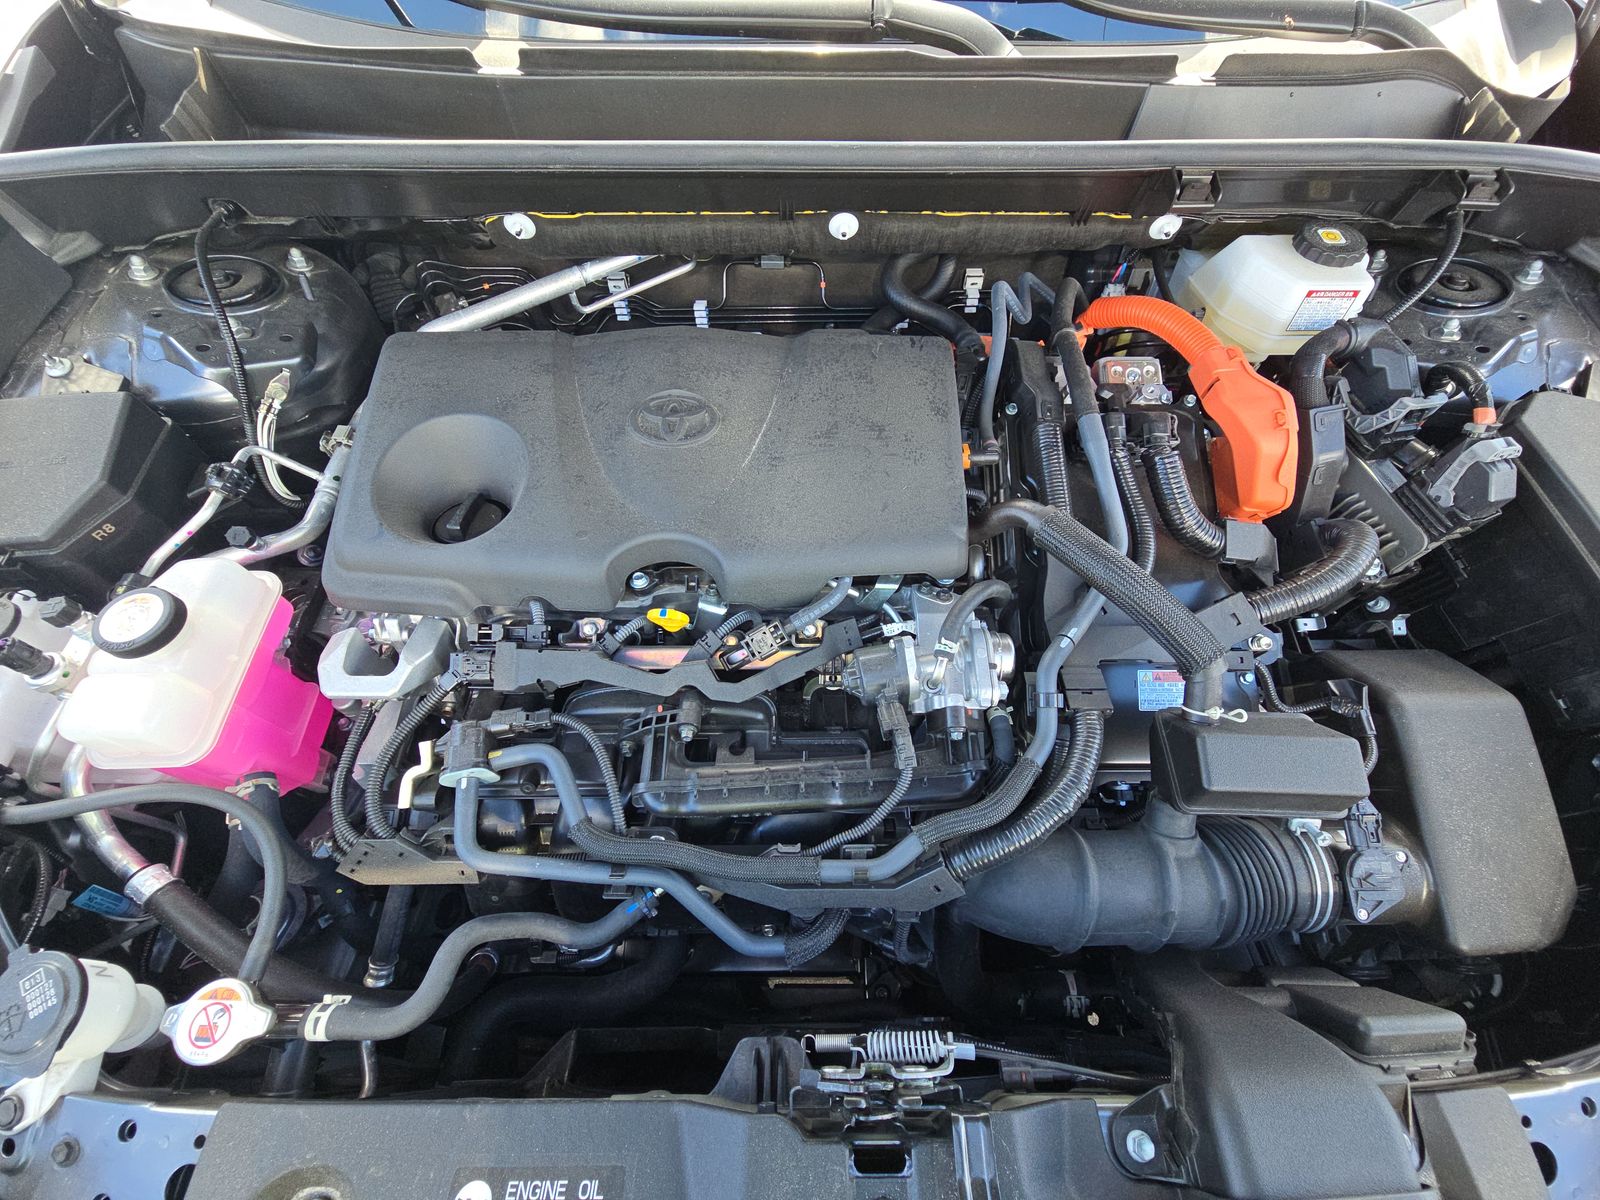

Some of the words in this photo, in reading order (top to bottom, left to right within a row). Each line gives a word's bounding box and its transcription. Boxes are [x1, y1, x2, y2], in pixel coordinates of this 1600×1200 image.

[91, 523, 116, 541] R8
[25, 979, 53, 1002] 000127
[28, 996, 57, 1020] 000145
[504, 1180, 568, 1200] ENGINE
[578, 1179, 604, 1200] OIL
